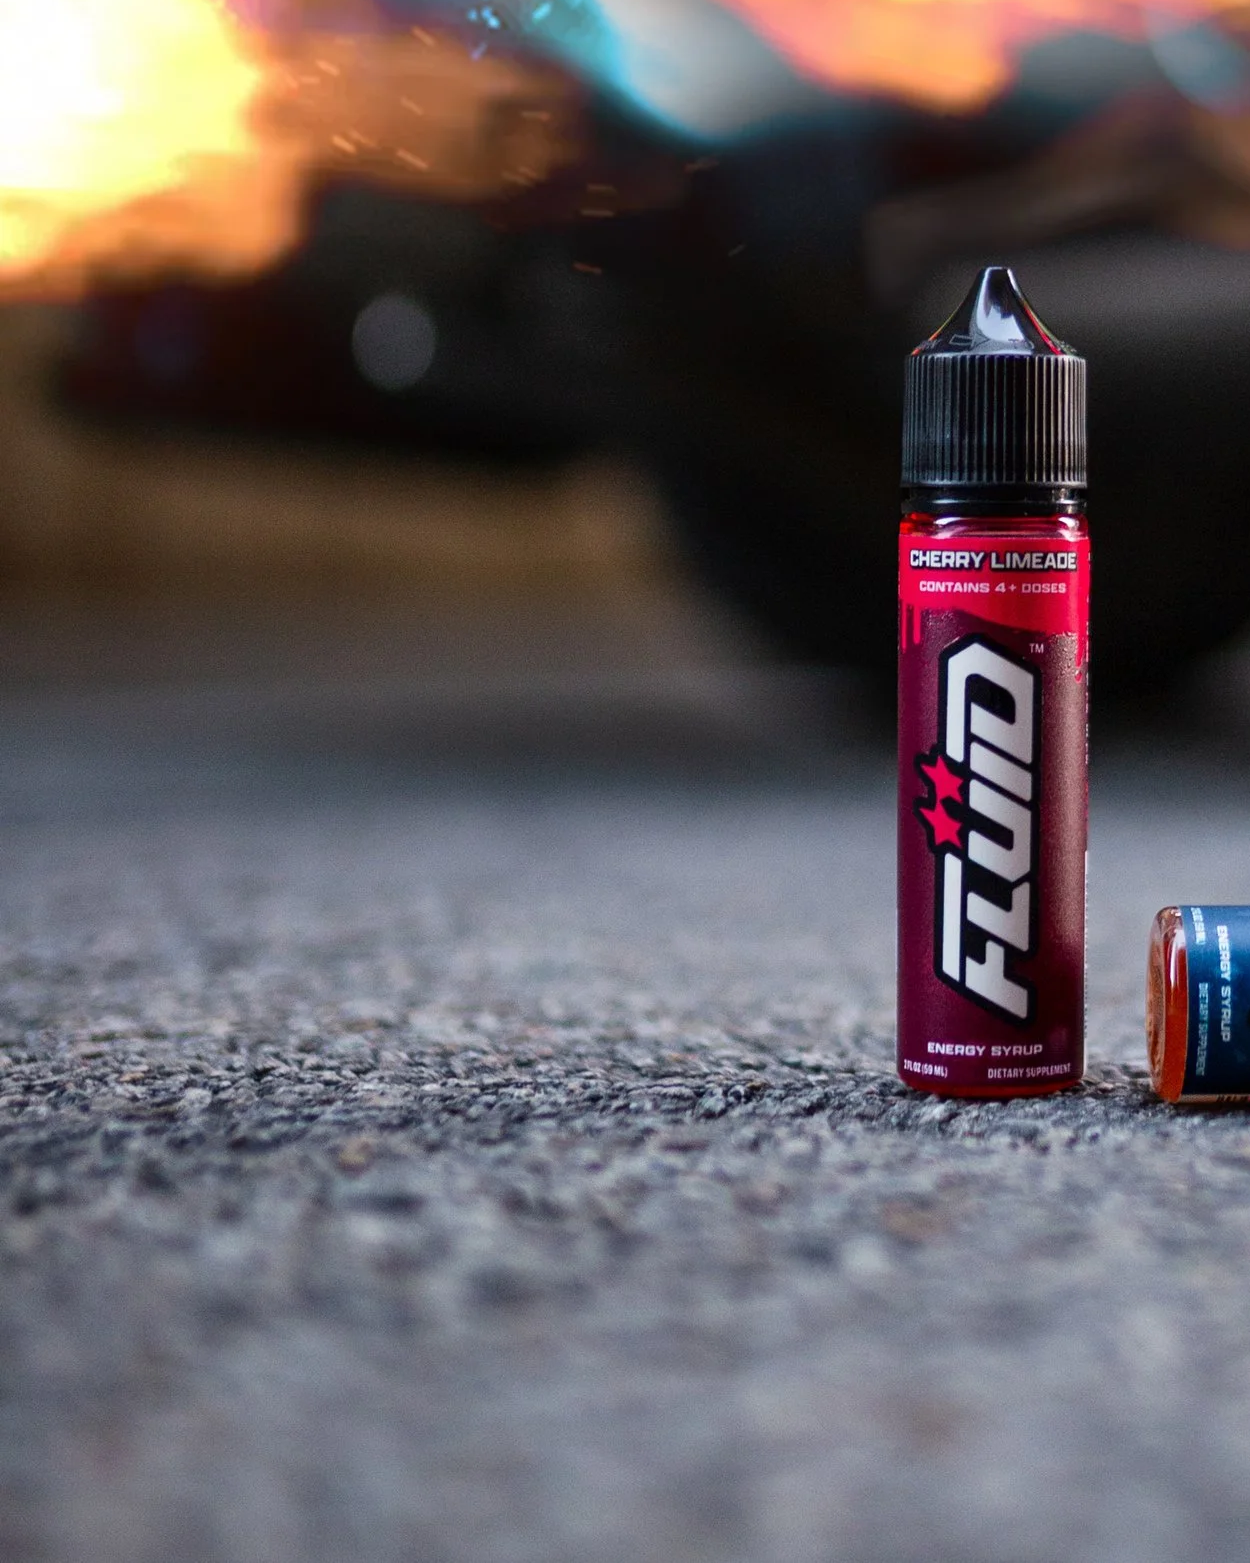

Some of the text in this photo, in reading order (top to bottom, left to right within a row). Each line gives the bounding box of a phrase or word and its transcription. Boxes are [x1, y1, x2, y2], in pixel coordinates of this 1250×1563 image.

[909, 549, 1077, 570] CHERRY LIMEADE
[919, 580, 1067, 594] CONTAINS 4+ DOSES
[1029, 643, 1044, 654] TM
[1216, 924, 1232, 1043] ENERGY SYRUP
[927, 1041, 1044, 1056] ENERGY SYRUP
[987, 1062, 1071, 1079] DIETARY SUPPLEMENT
